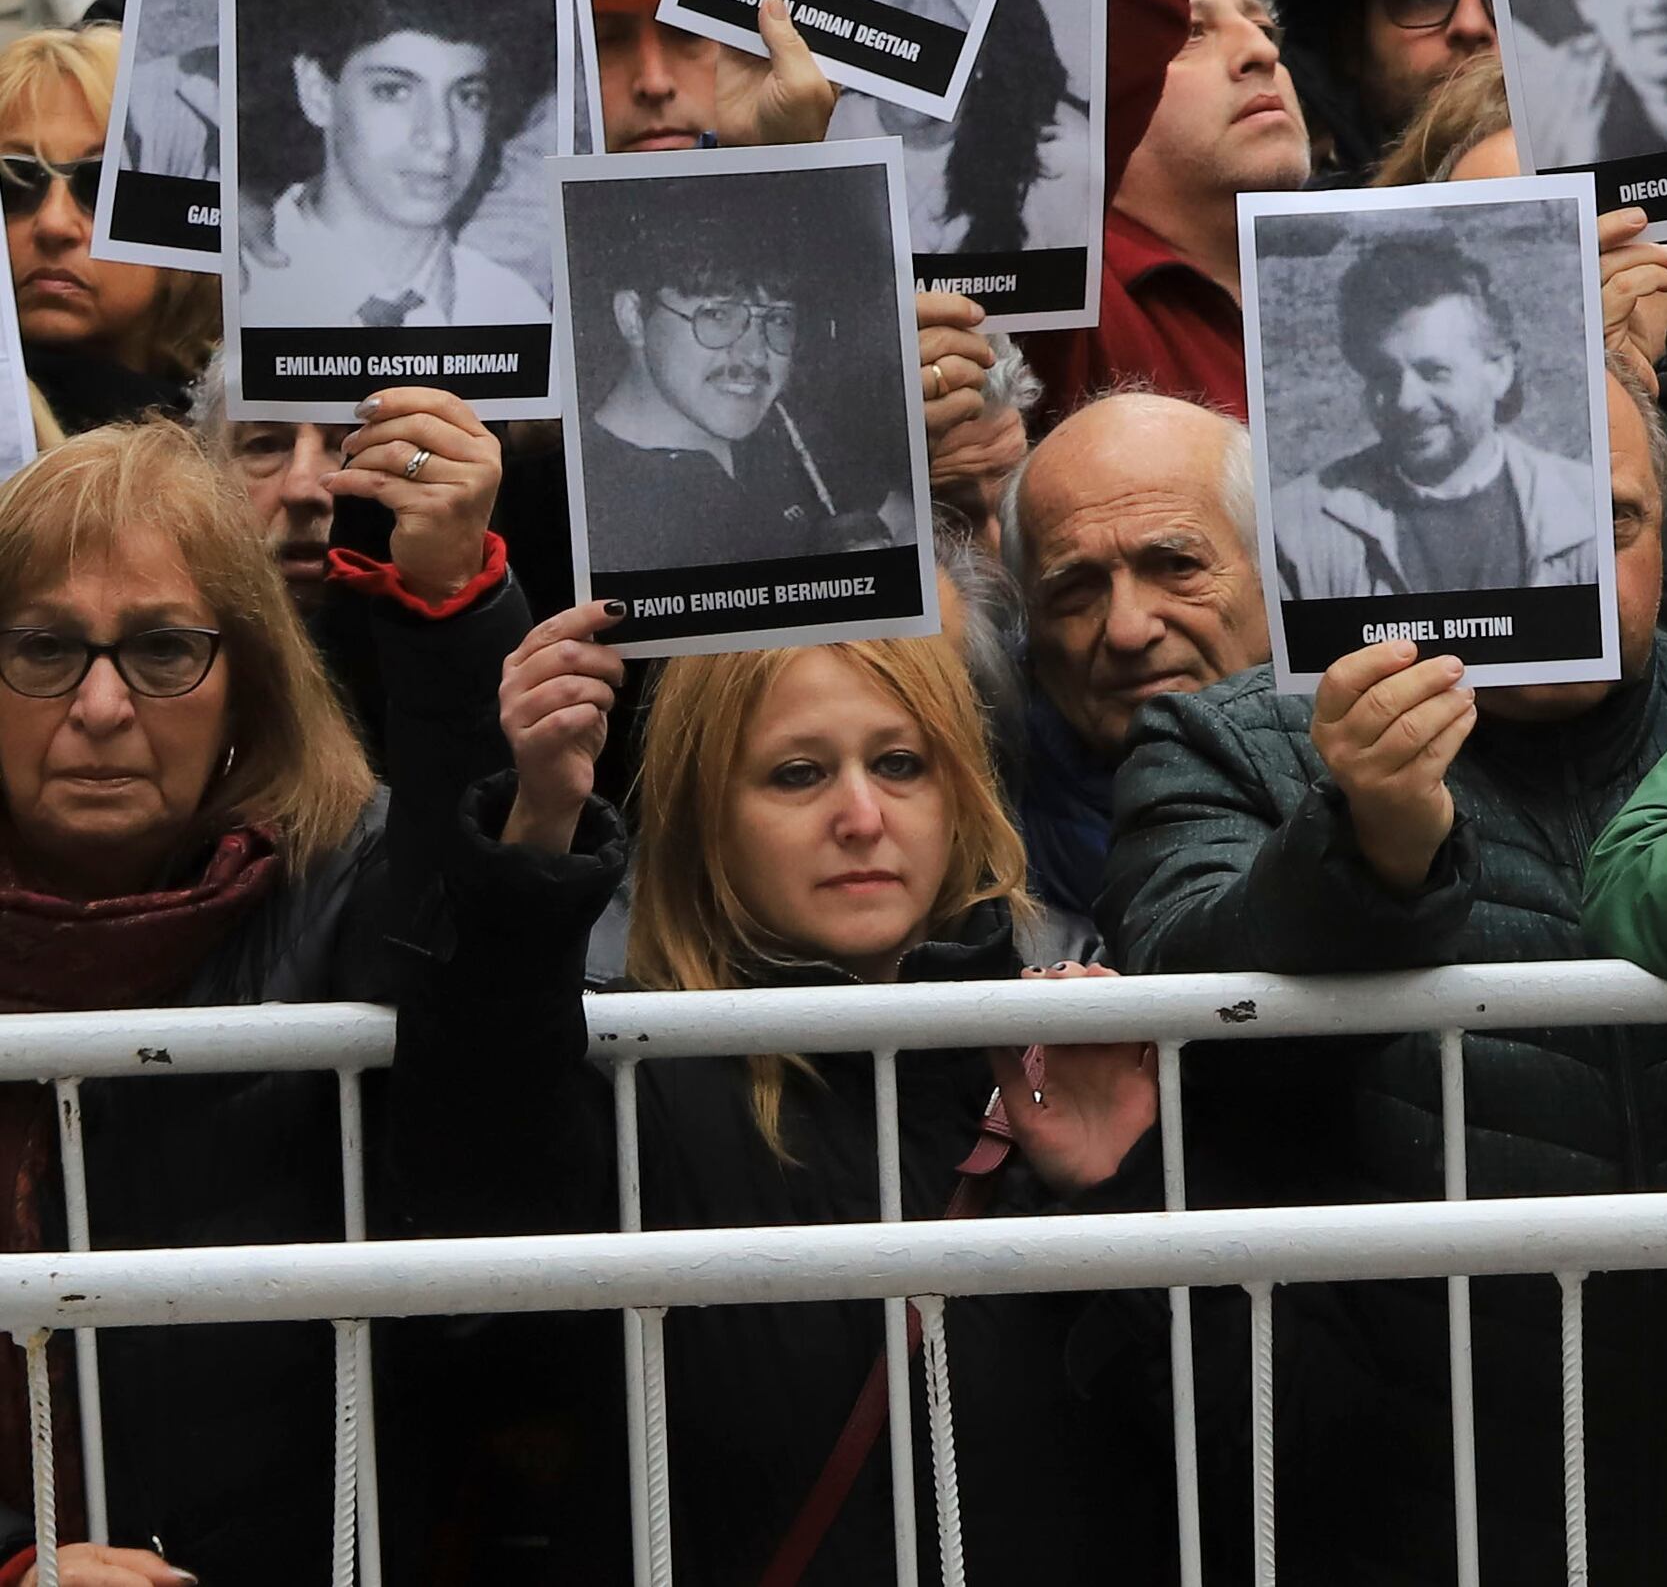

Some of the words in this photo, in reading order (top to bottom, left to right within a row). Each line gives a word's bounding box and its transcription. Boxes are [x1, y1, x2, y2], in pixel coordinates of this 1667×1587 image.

[794, 2, 854, 41] ADRIAN
[854, 24, 922, 63] DEGTIAR
[931, 274, 1017, 294] AVERBUCH
[274, 356, 363, 377] EMILIANO
[366, 355, 438, 376] GASTON
[442, 353, 519, 375] BRIKMAN
[632, 597, 685, 620] FAVIO
[690, 587, 770, 614] ENRIQUE
[774, 576, 876, 604] BERMUDEZ
[1362, 620, 1439, 645] GABRIEL
[1444, 616, 1513, 640] BUTTINI
